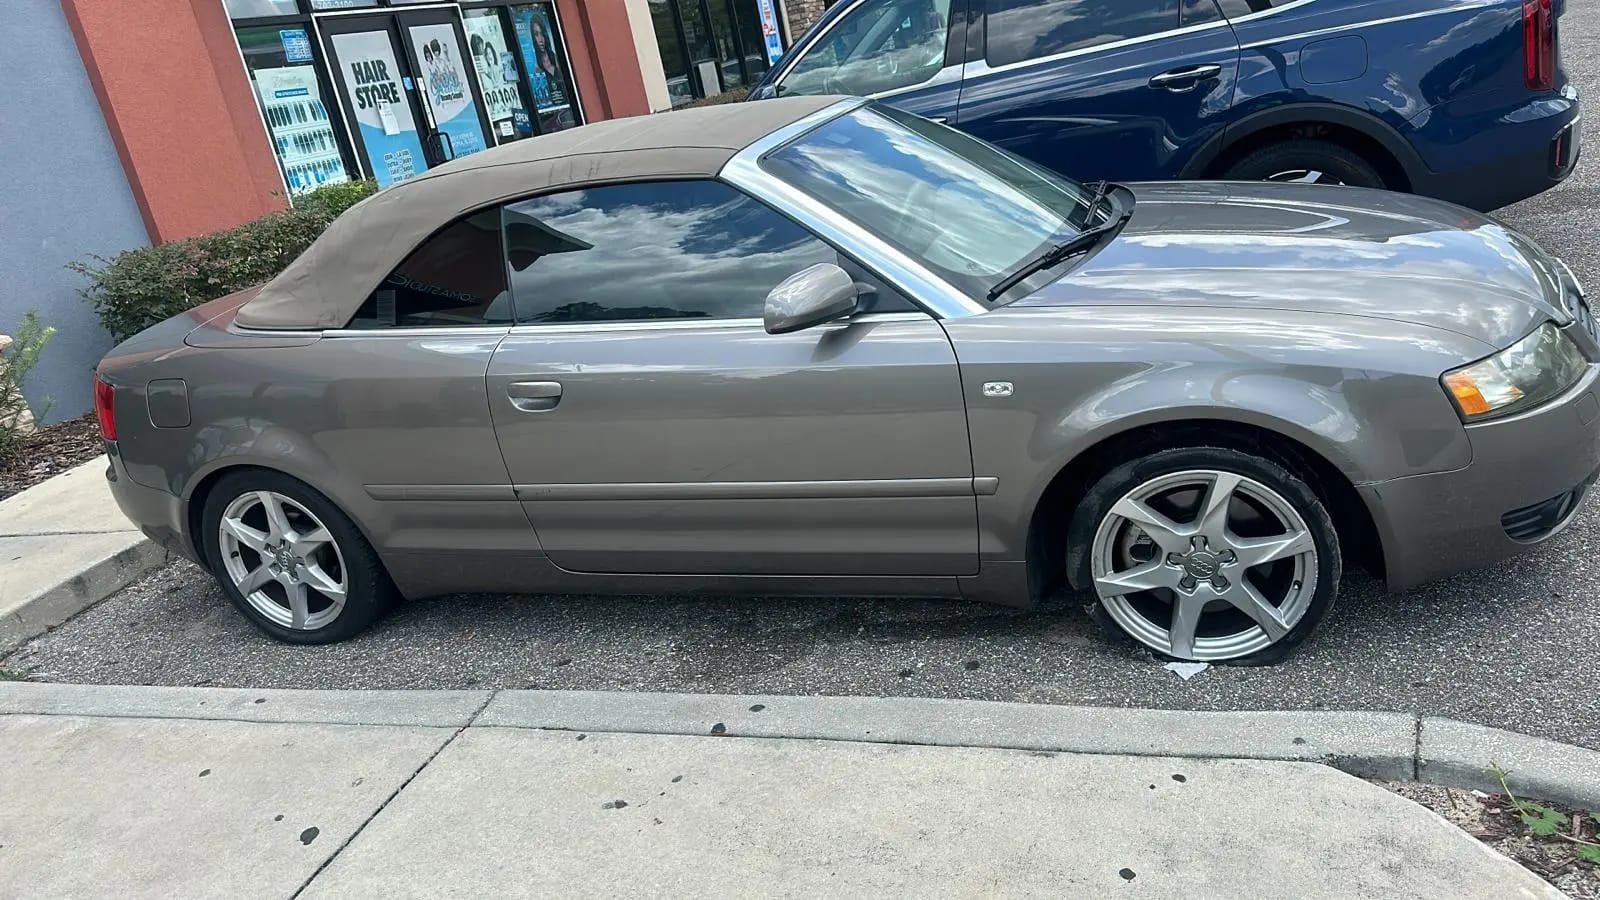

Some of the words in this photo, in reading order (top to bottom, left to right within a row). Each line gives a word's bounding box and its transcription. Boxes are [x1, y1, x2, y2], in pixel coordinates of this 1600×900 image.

[351, 59, 390, 85] HAIR
[355, 82, 400, 109] STORE
[514, 112, 529, 122] OPEN
